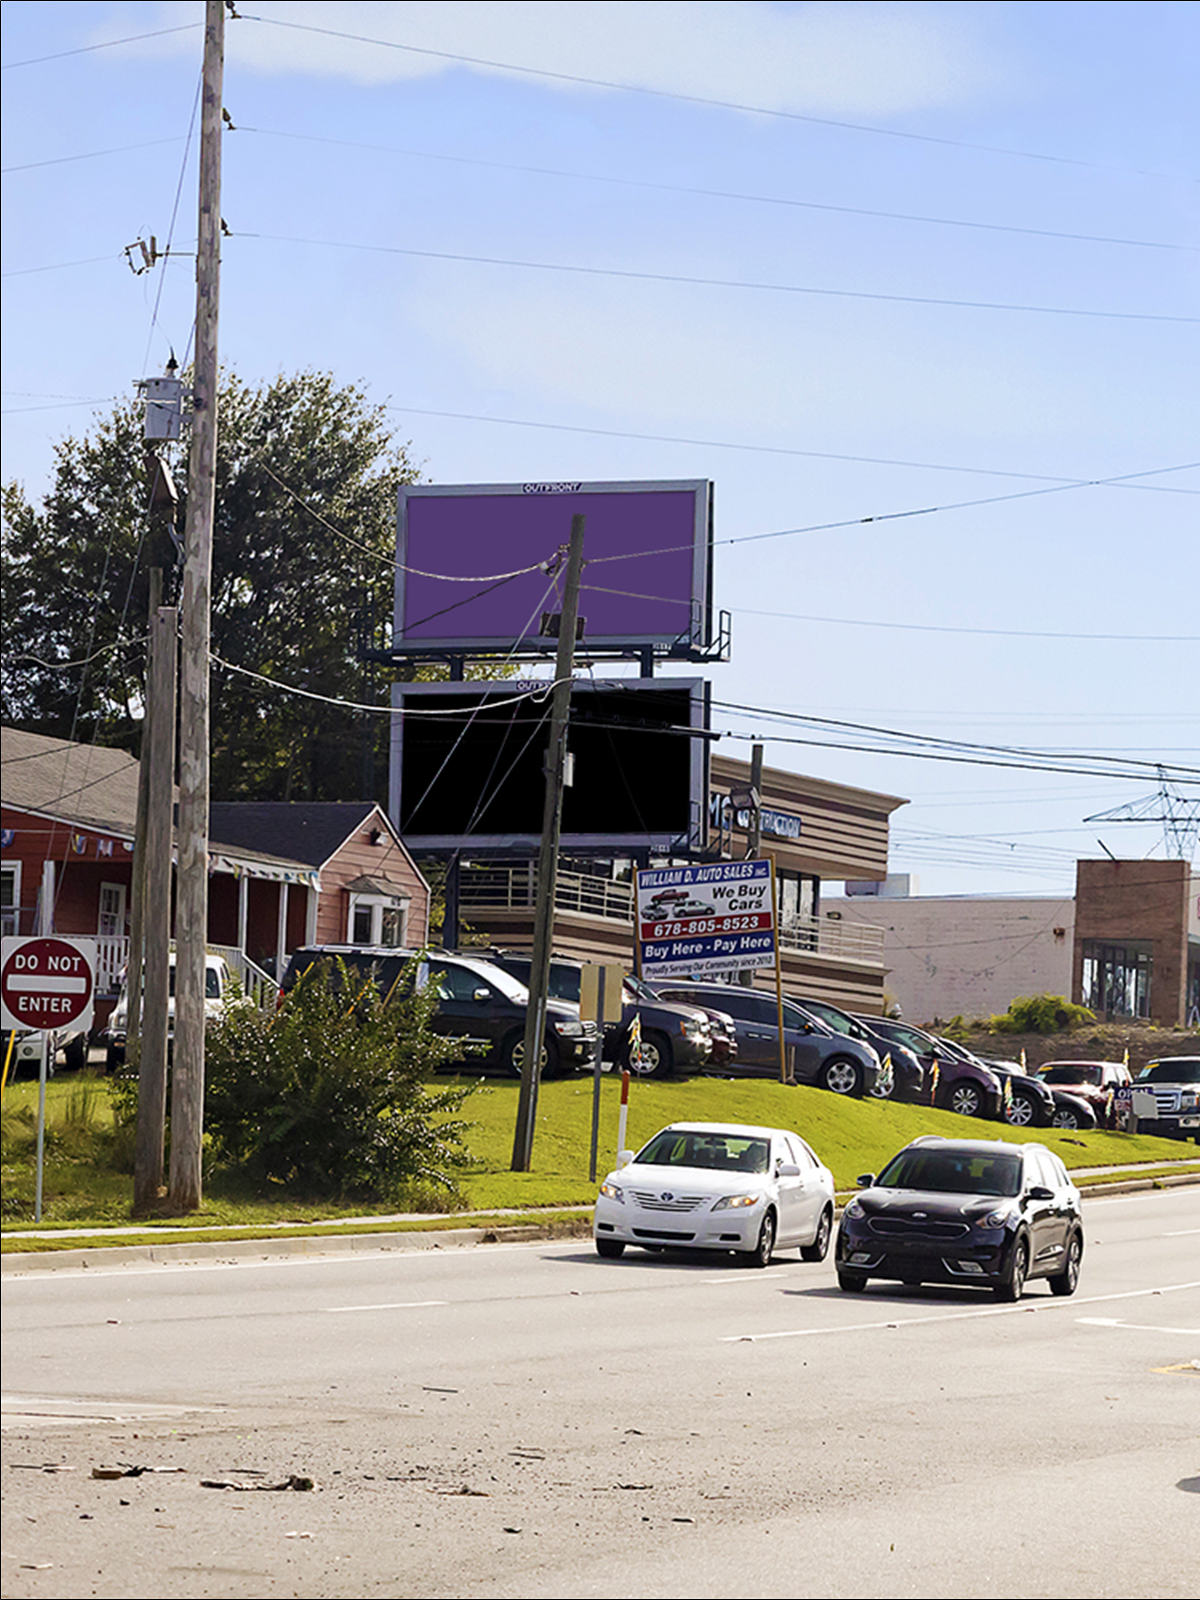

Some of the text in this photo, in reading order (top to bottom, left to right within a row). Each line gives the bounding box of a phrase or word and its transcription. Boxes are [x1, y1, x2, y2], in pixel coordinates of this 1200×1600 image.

[737, 807, 801, 838] COTRUCTION
[641, 870, 682, 887] WILLIAM
[684, 870, 693, 883] D.
[696, 866, 722, 881] AUTO
[724, 864, 753, 879] SALES
[712, 885, 766, 899] We Buy
[728, 899, 763, 911] Cars
[654, 916, 759, 937] 678-805-8523
[645, 945, 668, 959] Buy
[672, 943, 703, 955] Here
[714, 939, 737, 953] Pay
[740, 937, 771, 949] Here
[15, 954, 81, 971] DO NOT
[645, 965, 669, 975] Proudly
[669, 963, 692, 974] Serving
[693, 963, 704, 971] Our
[705, 959, 739, 970] Community
[741, 957, 756, 966] since
[19, 996, 72, 1013] ENTER
